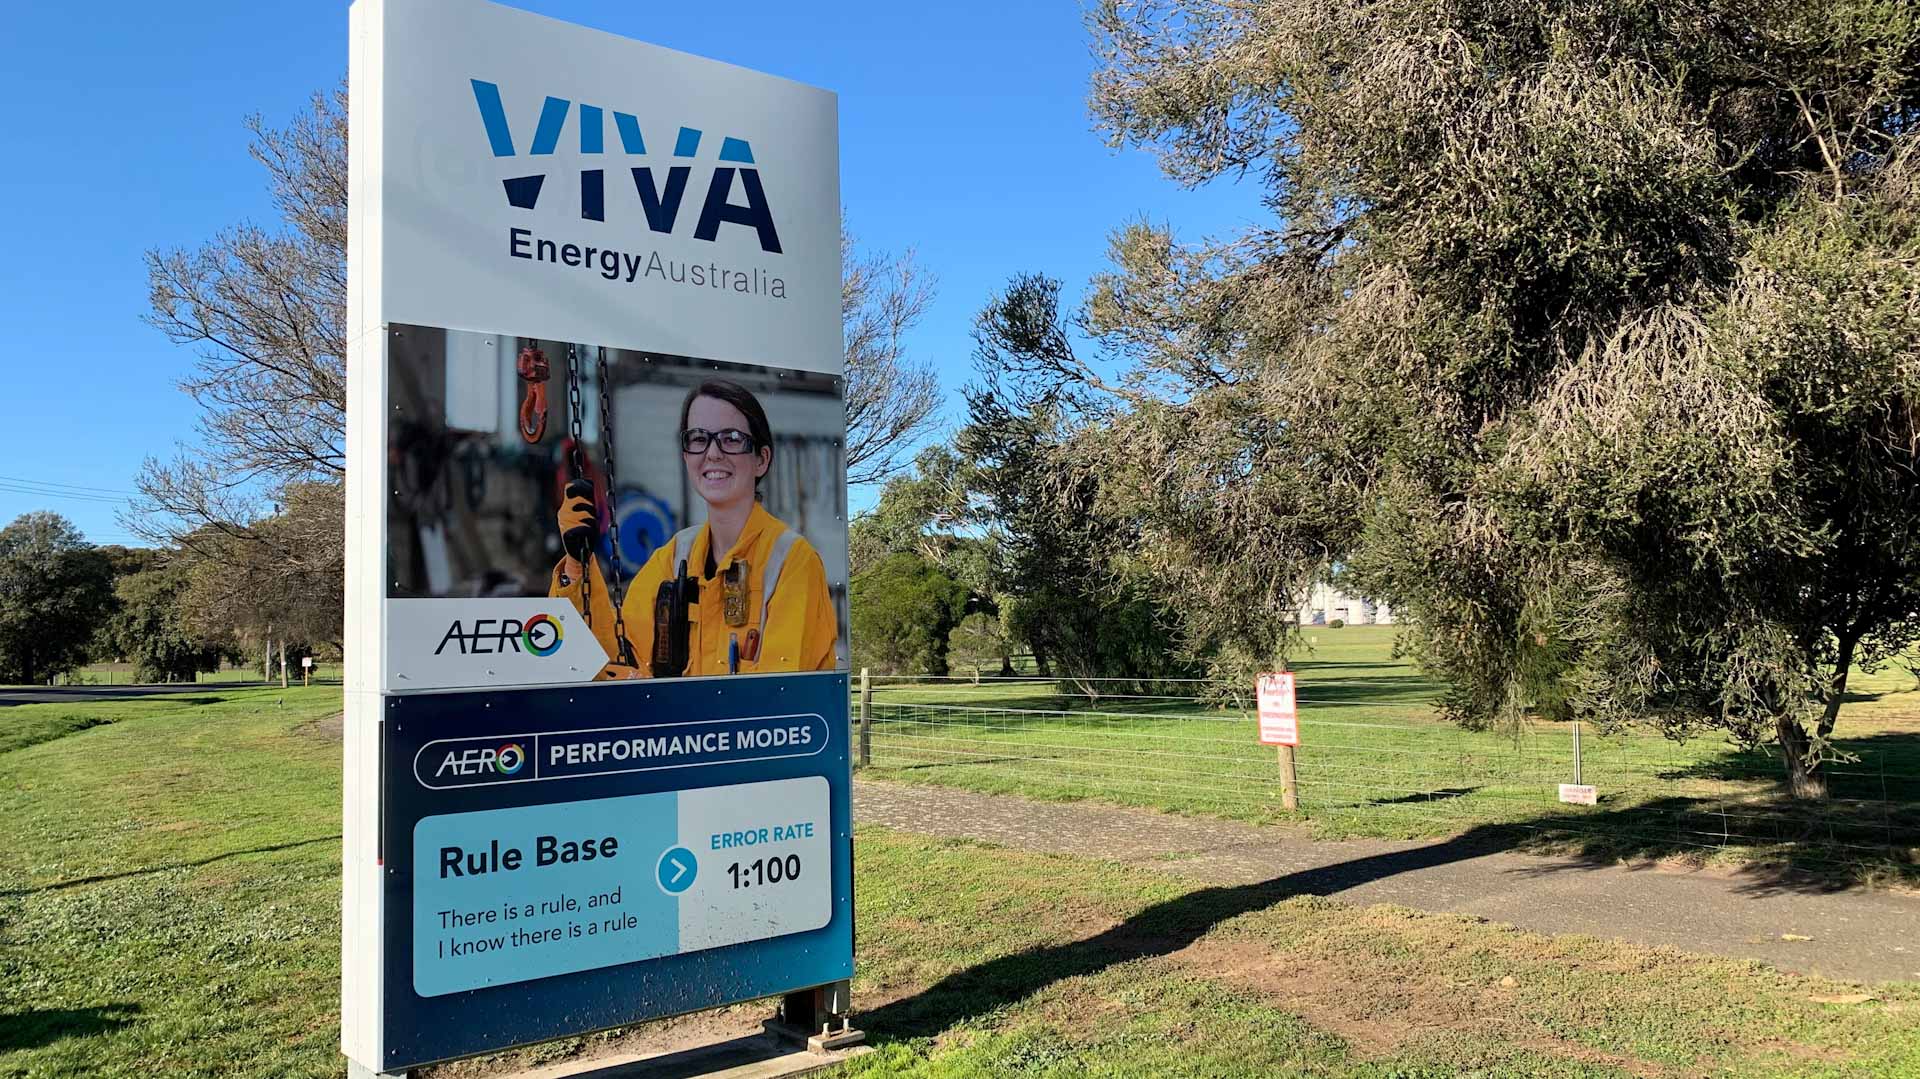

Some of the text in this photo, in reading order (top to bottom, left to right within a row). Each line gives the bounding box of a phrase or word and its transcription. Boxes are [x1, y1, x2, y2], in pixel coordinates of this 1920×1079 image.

[470, 78, 783, 255] VIVA
[434, 613, 564, 657] AERO
[435, 725, 812, 778] AERO PERFORMANCE MODES
[440, 835, 619, 879] Rule Base
[711, 822, 815, 850] ERROR RATE
[727, 854, 801, 890] 1:100
[437, 885, 622, 930] There is a rule, and
[438, 912, 638, 960] I know there is a rule
